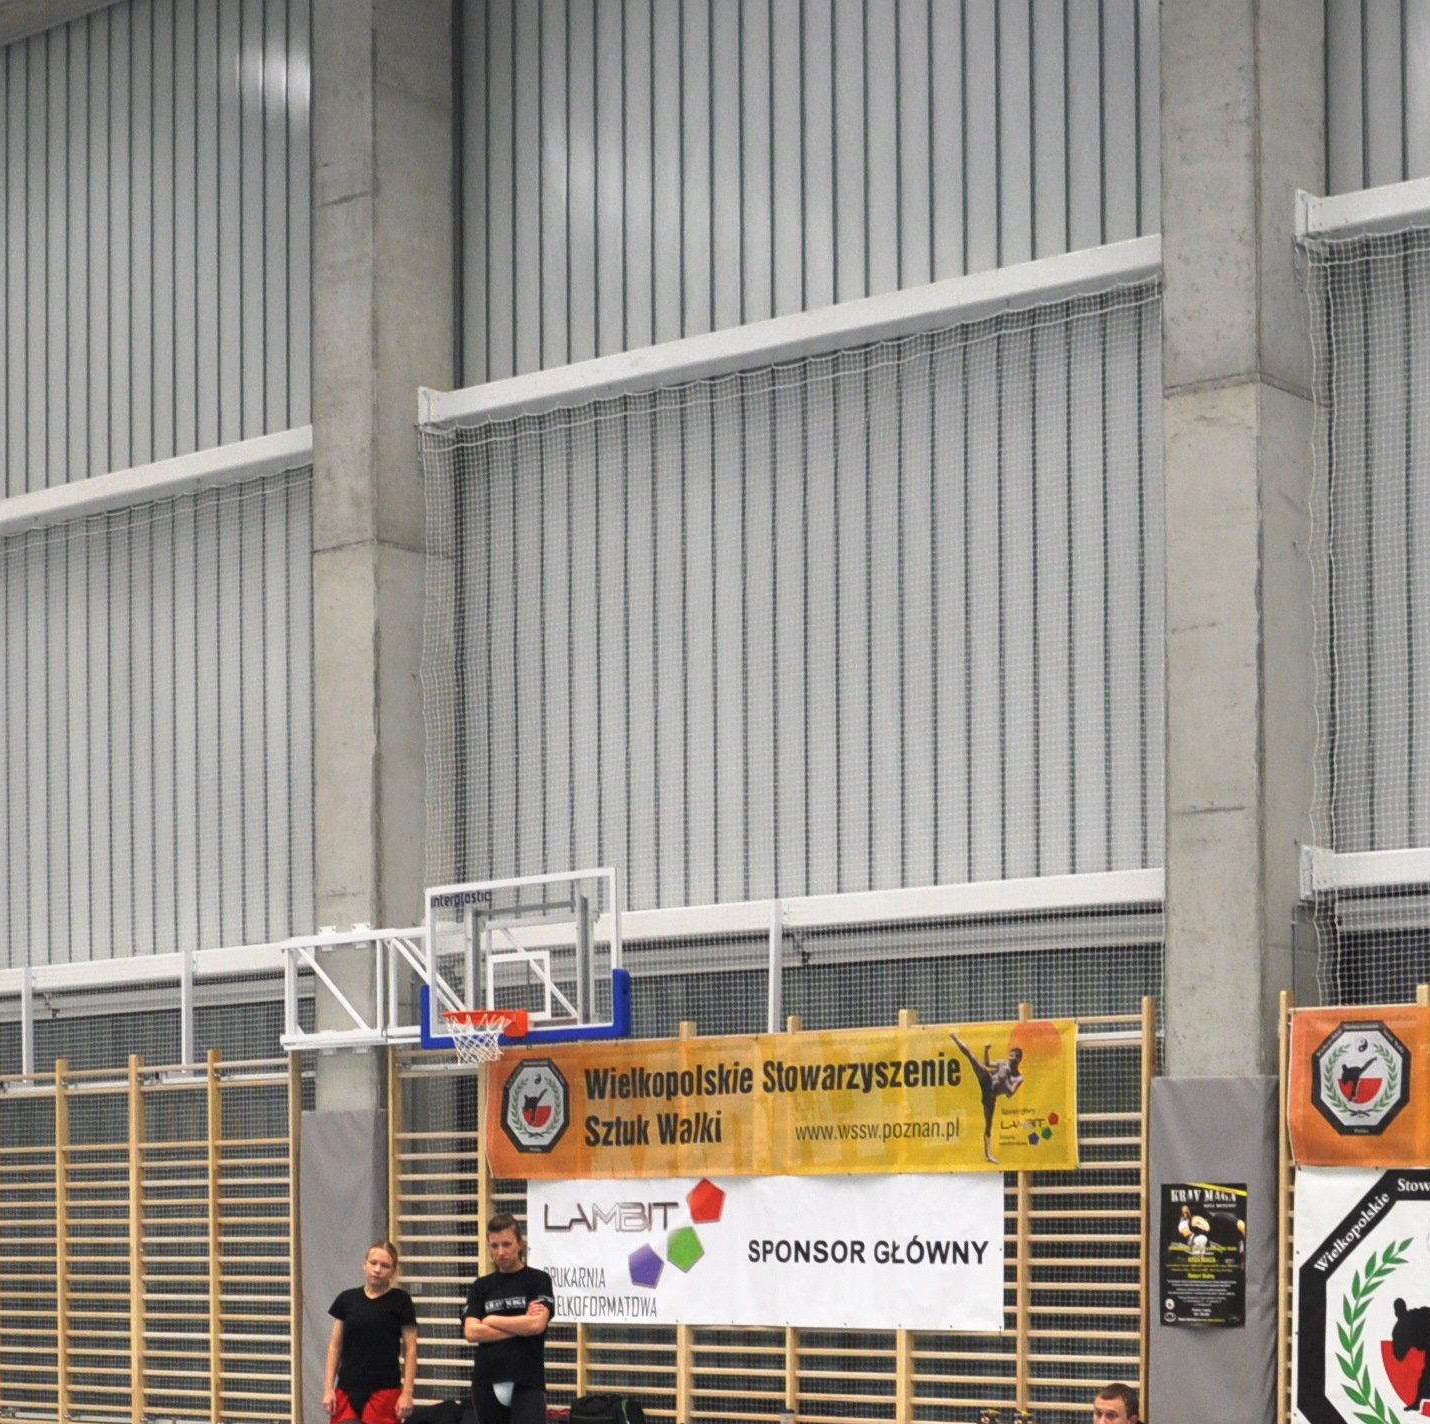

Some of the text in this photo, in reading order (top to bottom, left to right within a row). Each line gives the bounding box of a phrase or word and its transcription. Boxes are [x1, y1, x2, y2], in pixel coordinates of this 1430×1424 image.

[584, 1052, 962, 1101] Wielkopolskie Stowarzyszenie
[584, 1110, 722, 1147] Sztuk Walki
[795, 1118, 960, 1143] www.wssw.poznan.pl
[1171, 1189, 1237, 1203] KRAV MAGA
[544, 1202, 679, 1232] LAMBIT
[1313, 1192, 1390, 1273] Wielkopolskie
[748, 1235, 989, 1264] SPONSOR GŁÓWNY
[557, 1296, 658, 1318] ELKOFORMATOWA
